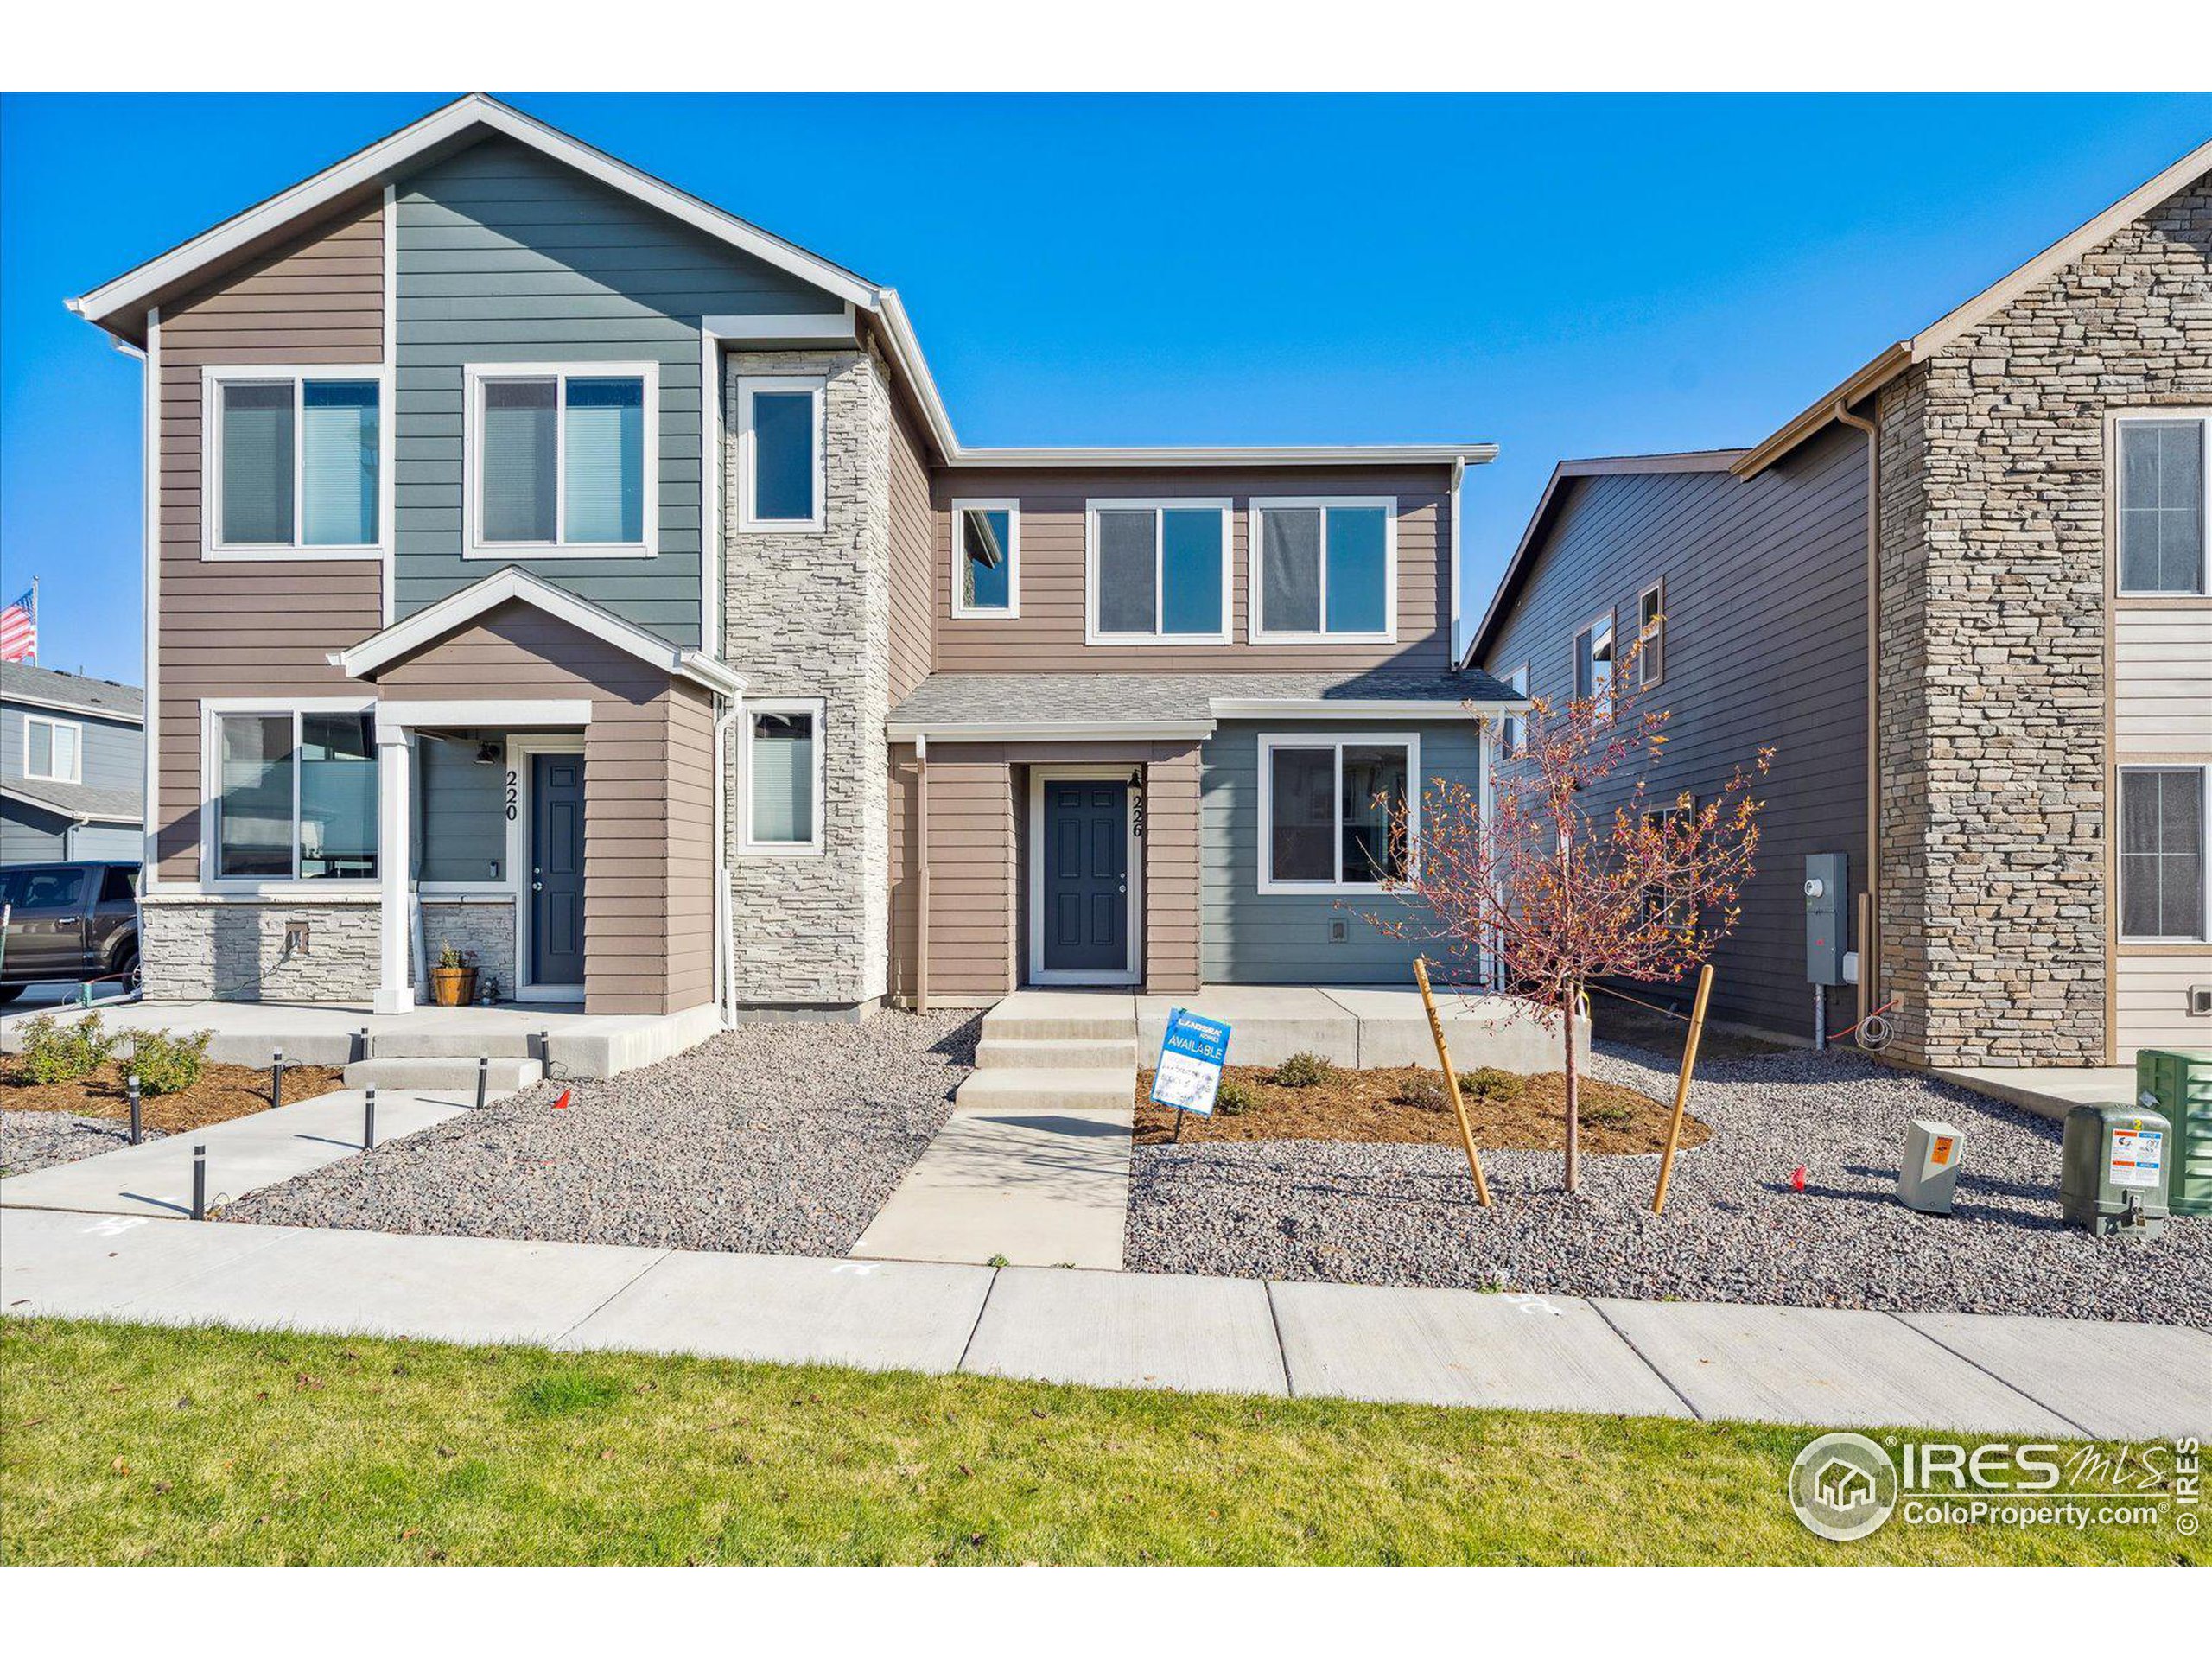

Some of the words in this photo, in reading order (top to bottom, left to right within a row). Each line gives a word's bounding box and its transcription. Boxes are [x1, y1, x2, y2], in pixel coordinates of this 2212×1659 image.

[506, 771, 518, 821] 220
[1133, 796, 1142, 837] 226
[1168, 1035, 1223, 1059] AVAILABLE
[2133, 1118, 2143, 1131] 2
